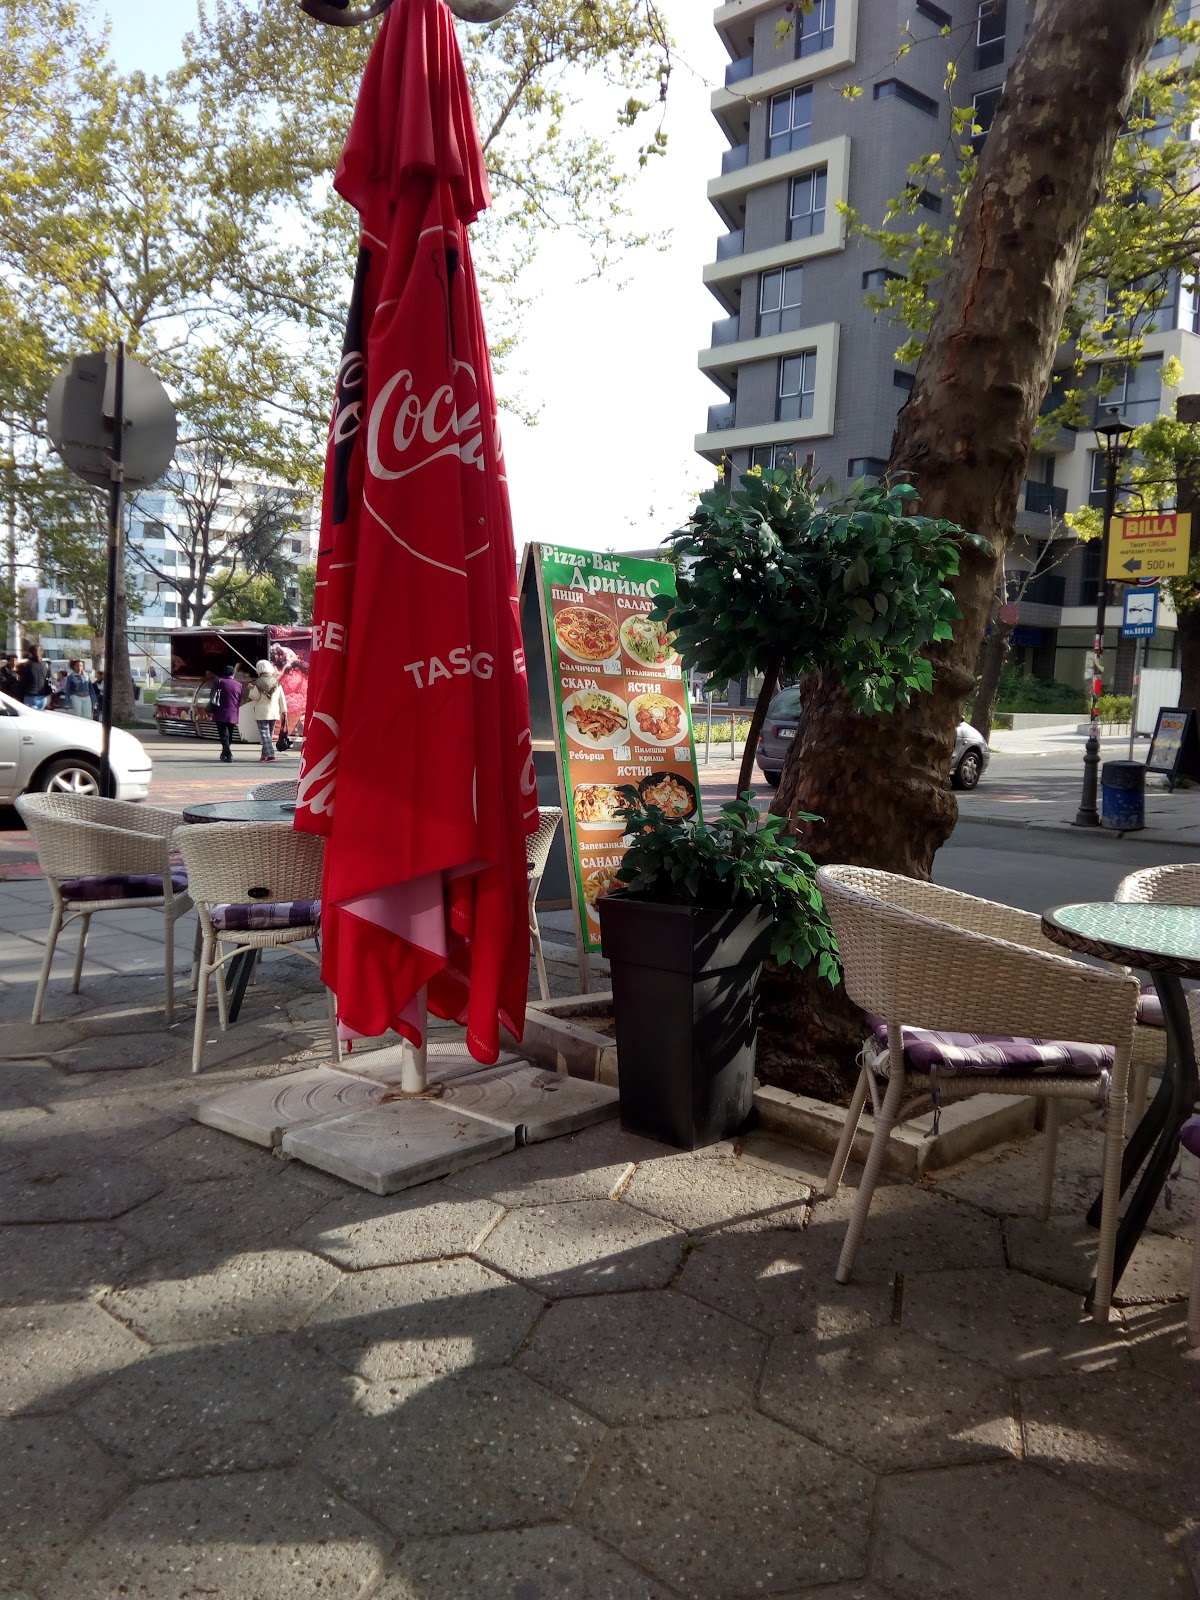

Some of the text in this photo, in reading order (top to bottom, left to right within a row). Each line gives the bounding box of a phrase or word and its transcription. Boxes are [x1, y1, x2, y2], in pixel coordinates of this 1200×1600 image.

[1126, 519, 1173, 536] BILLA
[1147, 559, 1166, 570] 500
[551, 588, 584, 604] ПИЦИ
[561, 677, 599, 690] СКАРА
[627, 682, 662, 694] ЯСТИЯ
[569, 749, 605, 761] Ребърца
[617, 765, 652, 777] ЯСТИЯ
